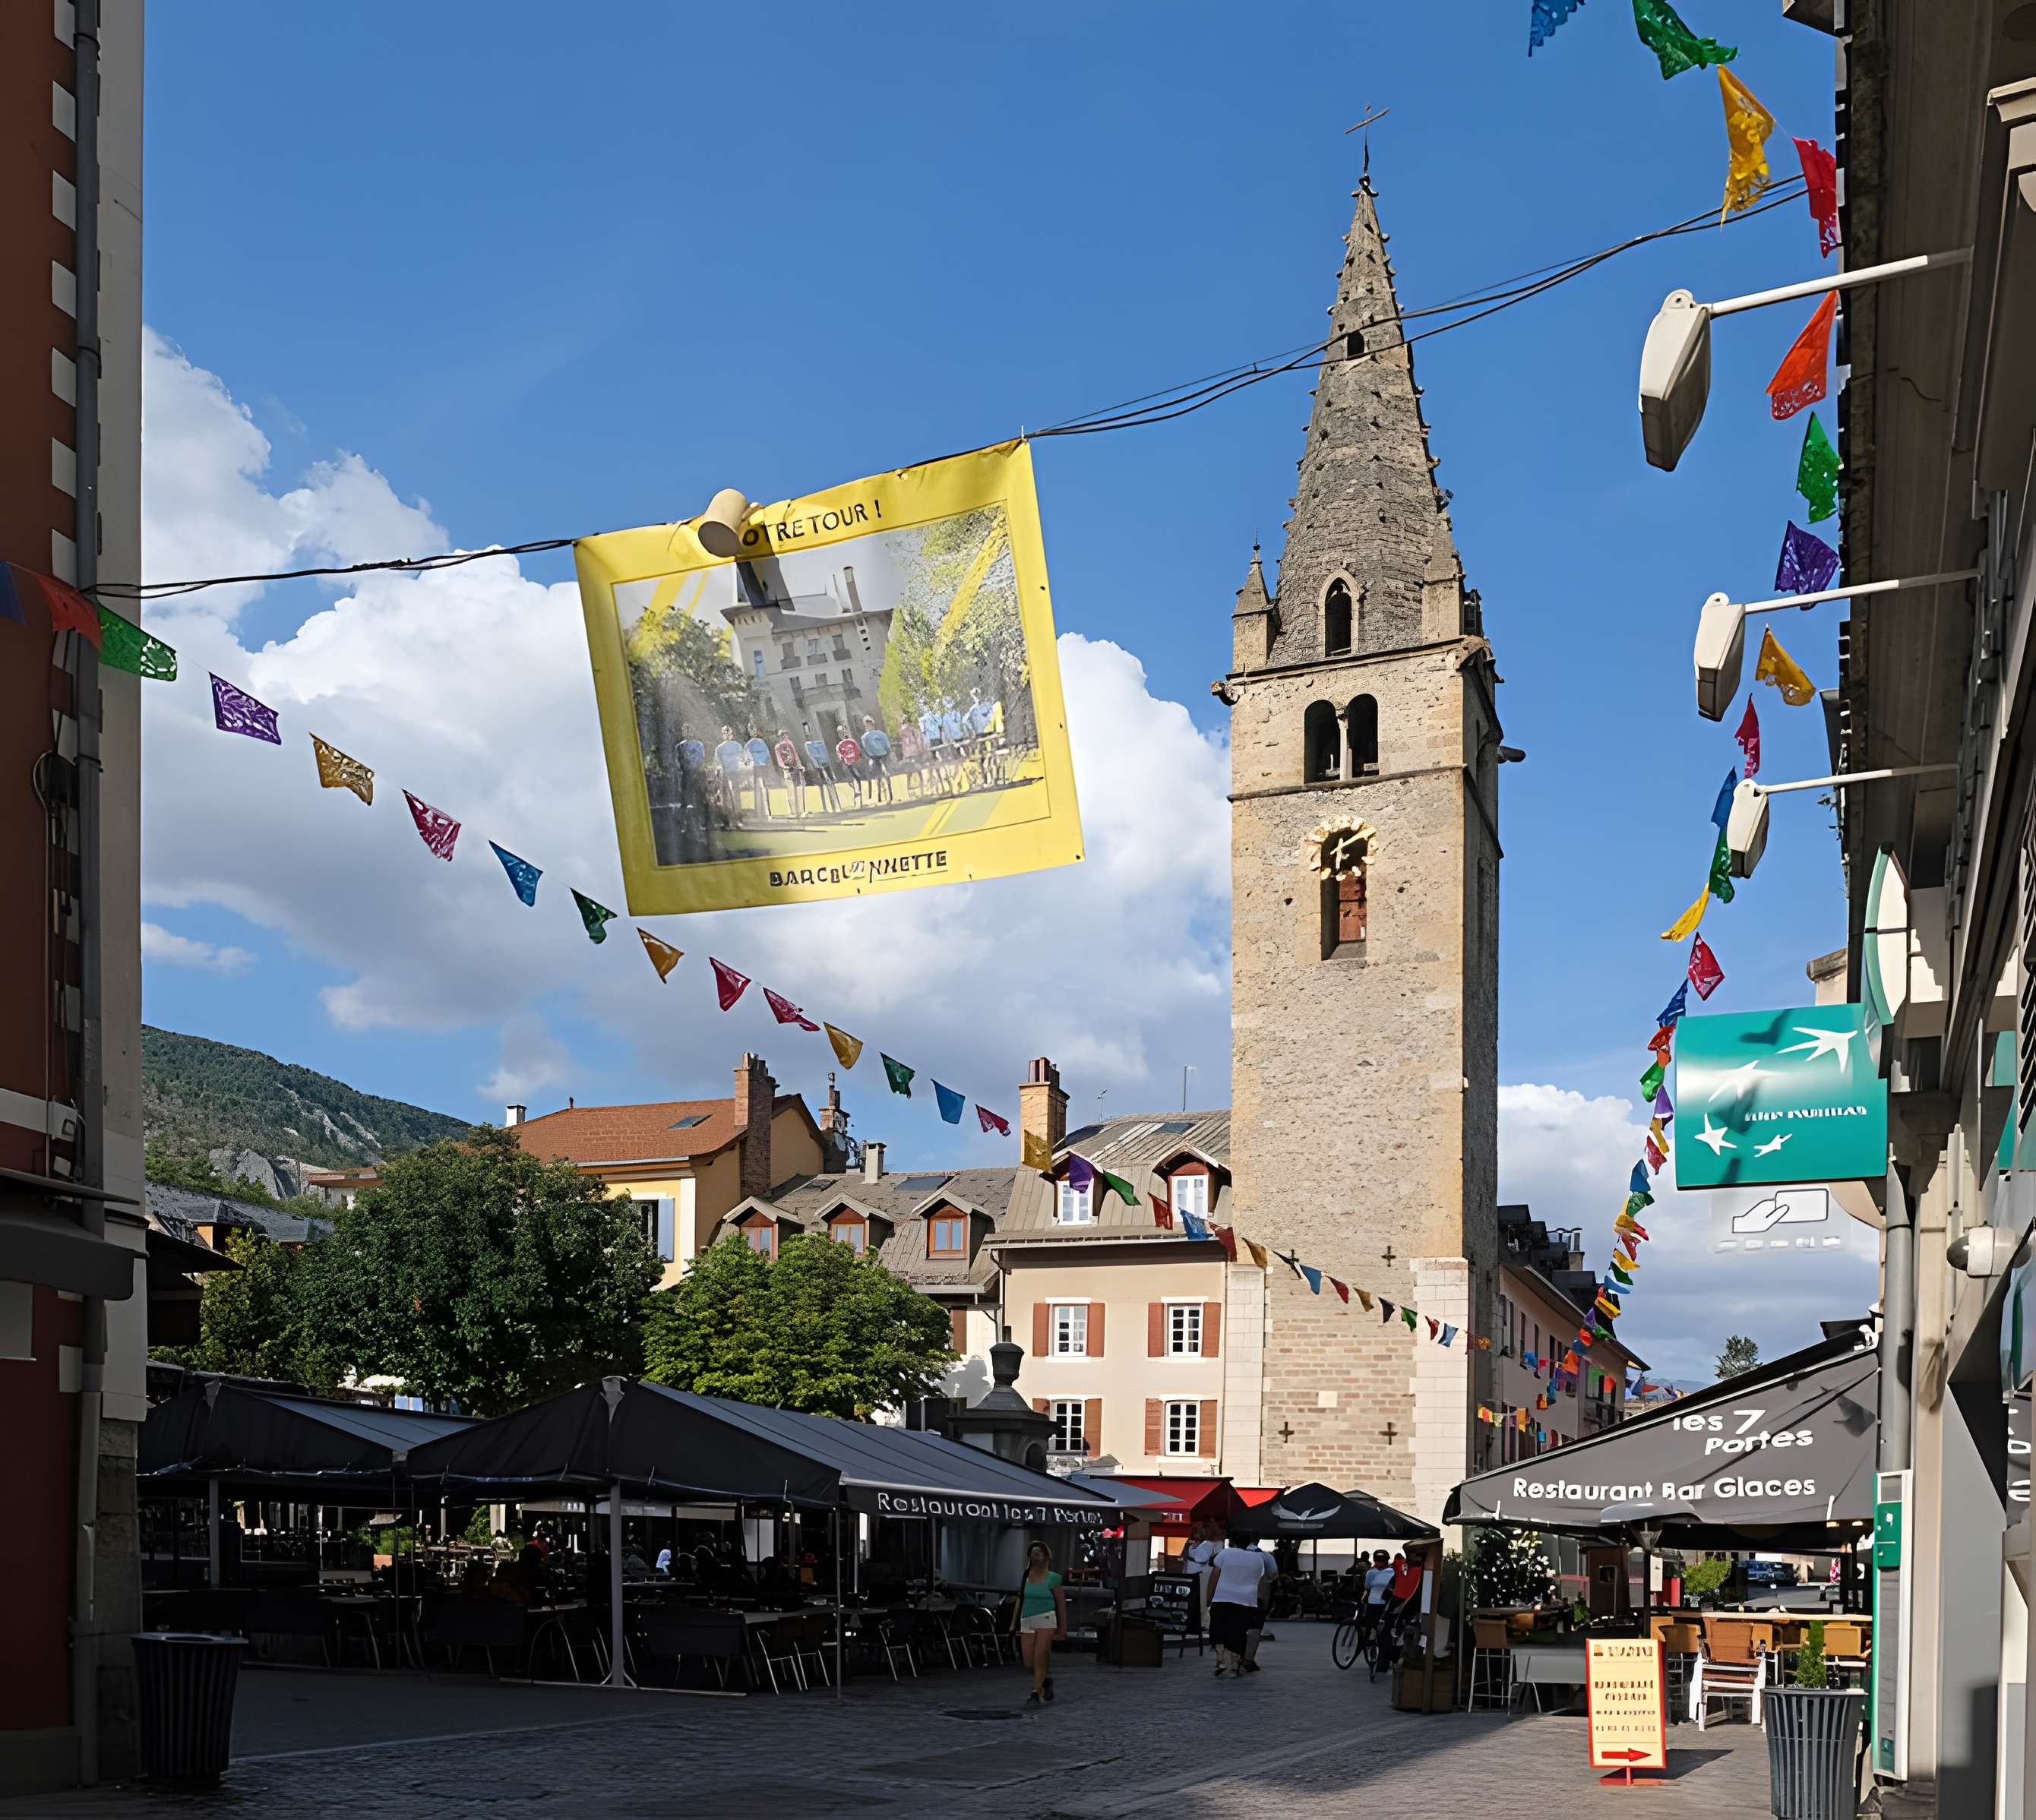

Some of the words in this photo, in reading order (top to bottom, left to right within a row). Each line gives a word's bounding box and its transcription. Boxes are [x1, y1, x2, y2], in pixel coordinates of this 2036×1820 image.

[742, 522, 805, 546] OTRE
[807, 504, 868, 533] TOUR
[1674, 1414, 1723, 1431] les
[1733, 1409, 1766, 1435] 7
[1704, 1429, 1813, 1456] Portes
[1513, 1477, 1653, 1501] Restaurant
[1662, 1482, 1706, 1501] Bar
[1714, 1476, 1816, 1498] Glaces
